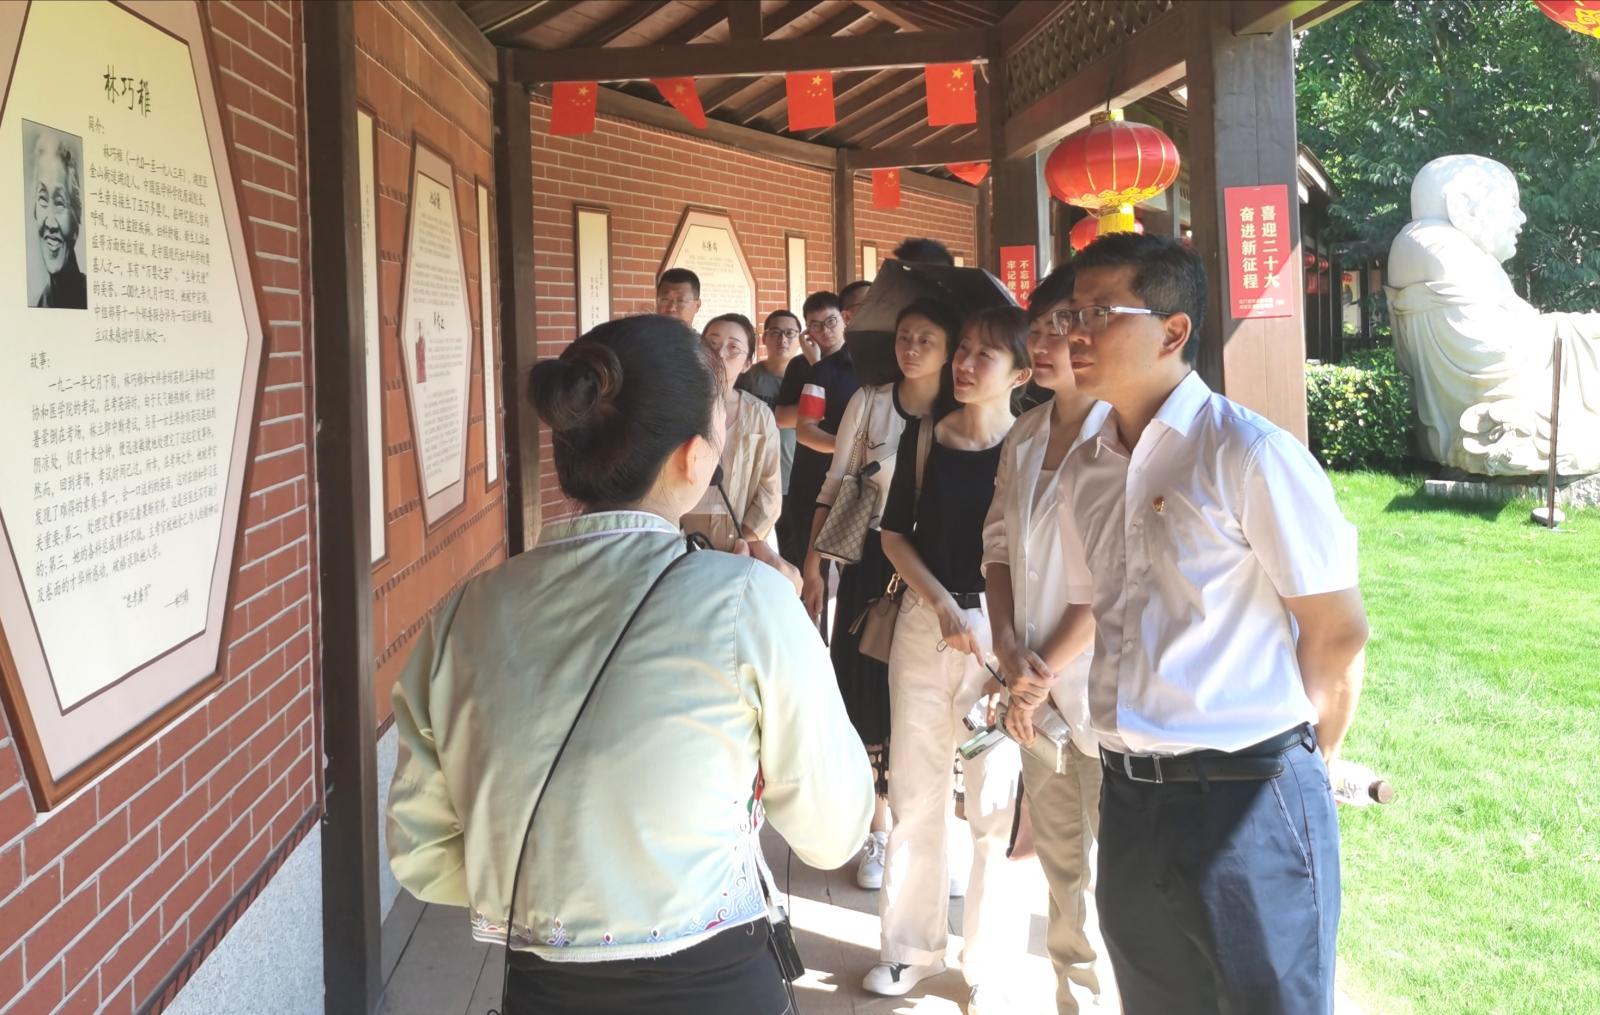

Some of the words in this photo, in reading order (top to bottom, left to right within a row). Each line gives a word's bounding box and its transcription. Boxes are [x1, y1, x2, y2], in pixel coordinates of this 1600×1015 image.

[1019, 260, 1031, 300] 不忘初心
[1239, 207, 1259, 290] 奋进新征程
[1261, 205, 1281, 289] 喜迎二十大
